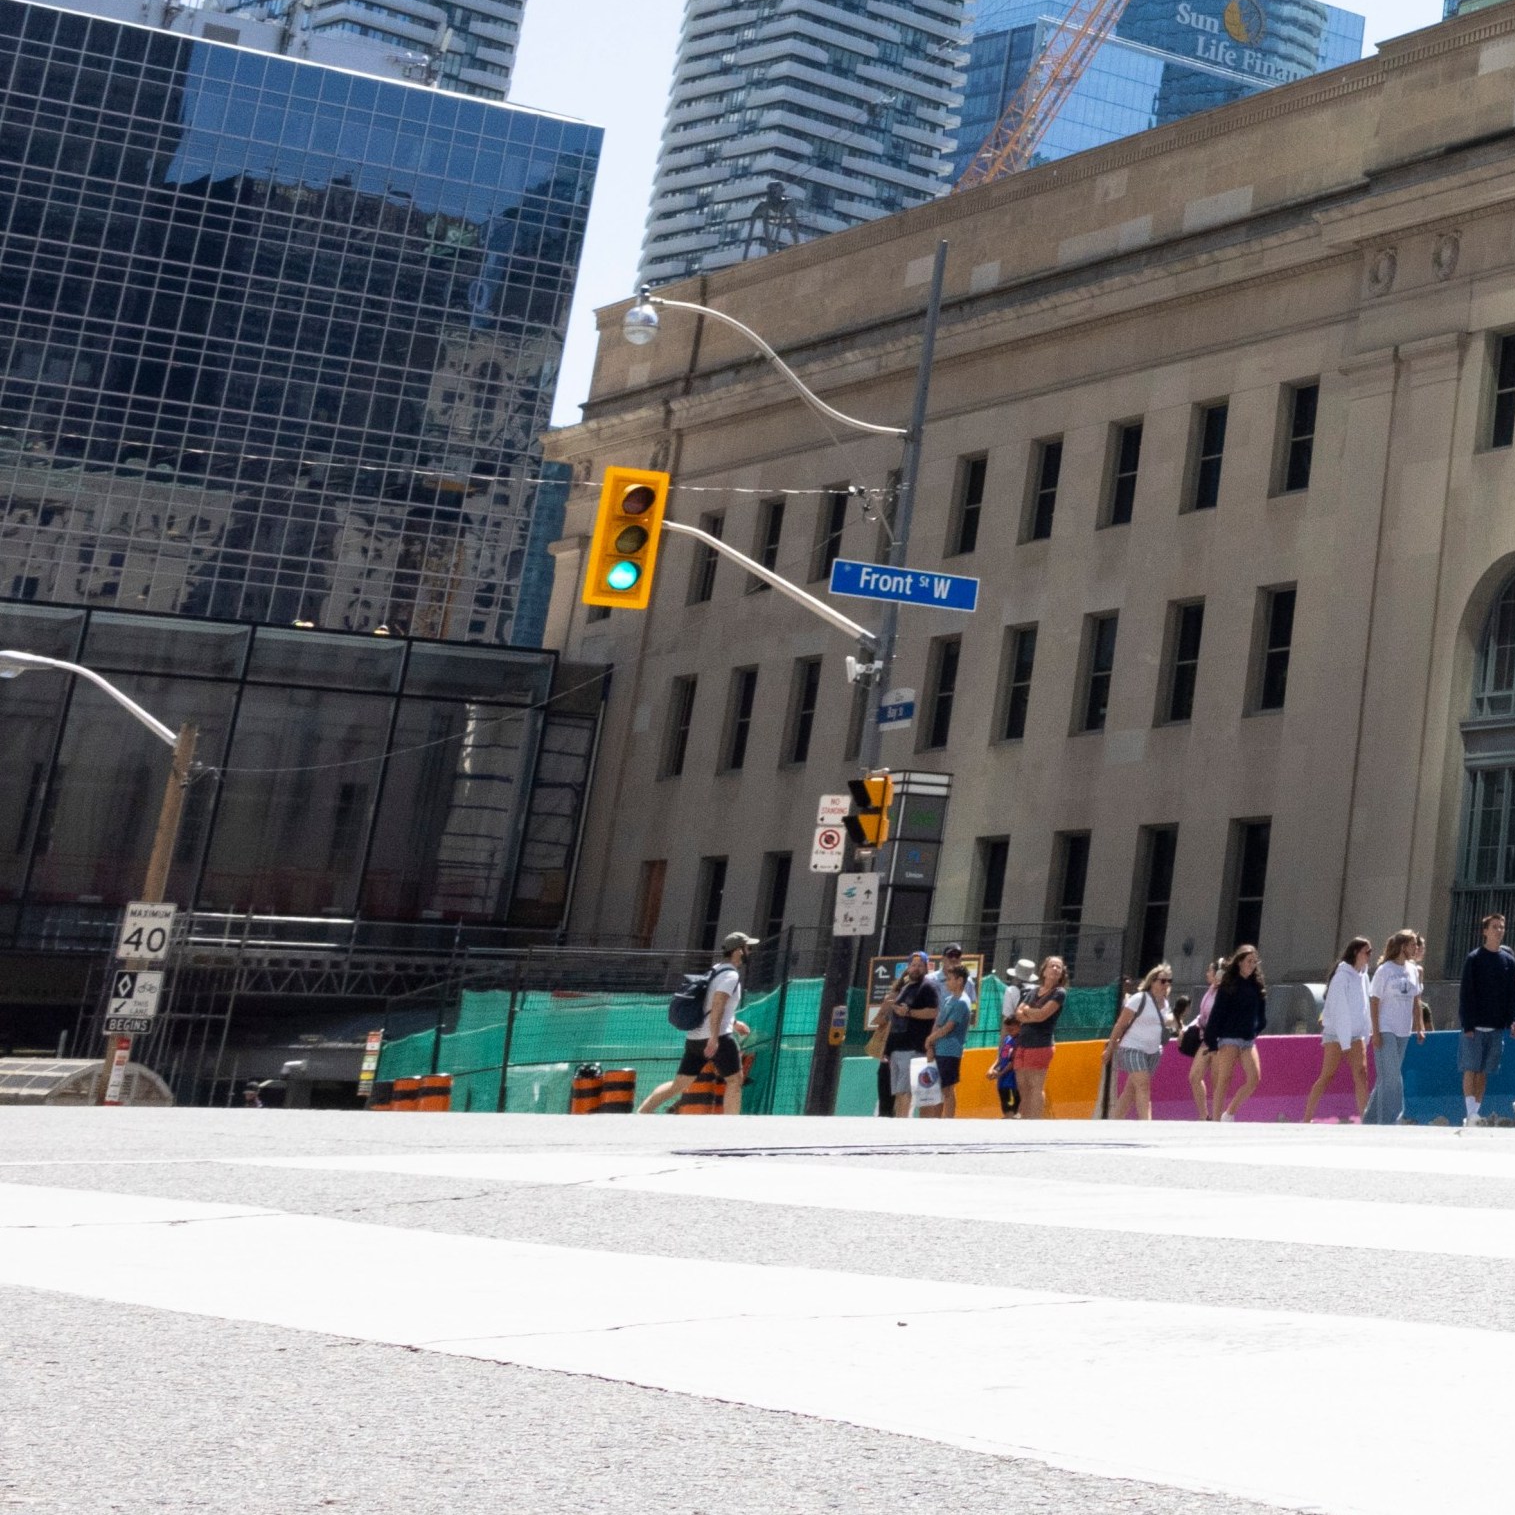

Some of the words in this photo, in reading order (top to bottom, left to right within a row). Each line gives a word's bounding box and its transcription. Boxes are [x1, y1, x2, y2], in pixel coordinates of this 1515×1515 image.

[1176, 3, 1219, 34] Sun
[1195, 35, 1237, 65] Life
[859, 567, 913, 595] Front
[919, 575, 930, 588] St
[933, 577, 951, 599] W
[130, 909, 171, 918] MAXIMUM
[123, 927, 166, 953] 40
[109, 1017, 148, 1031] BEGINS
